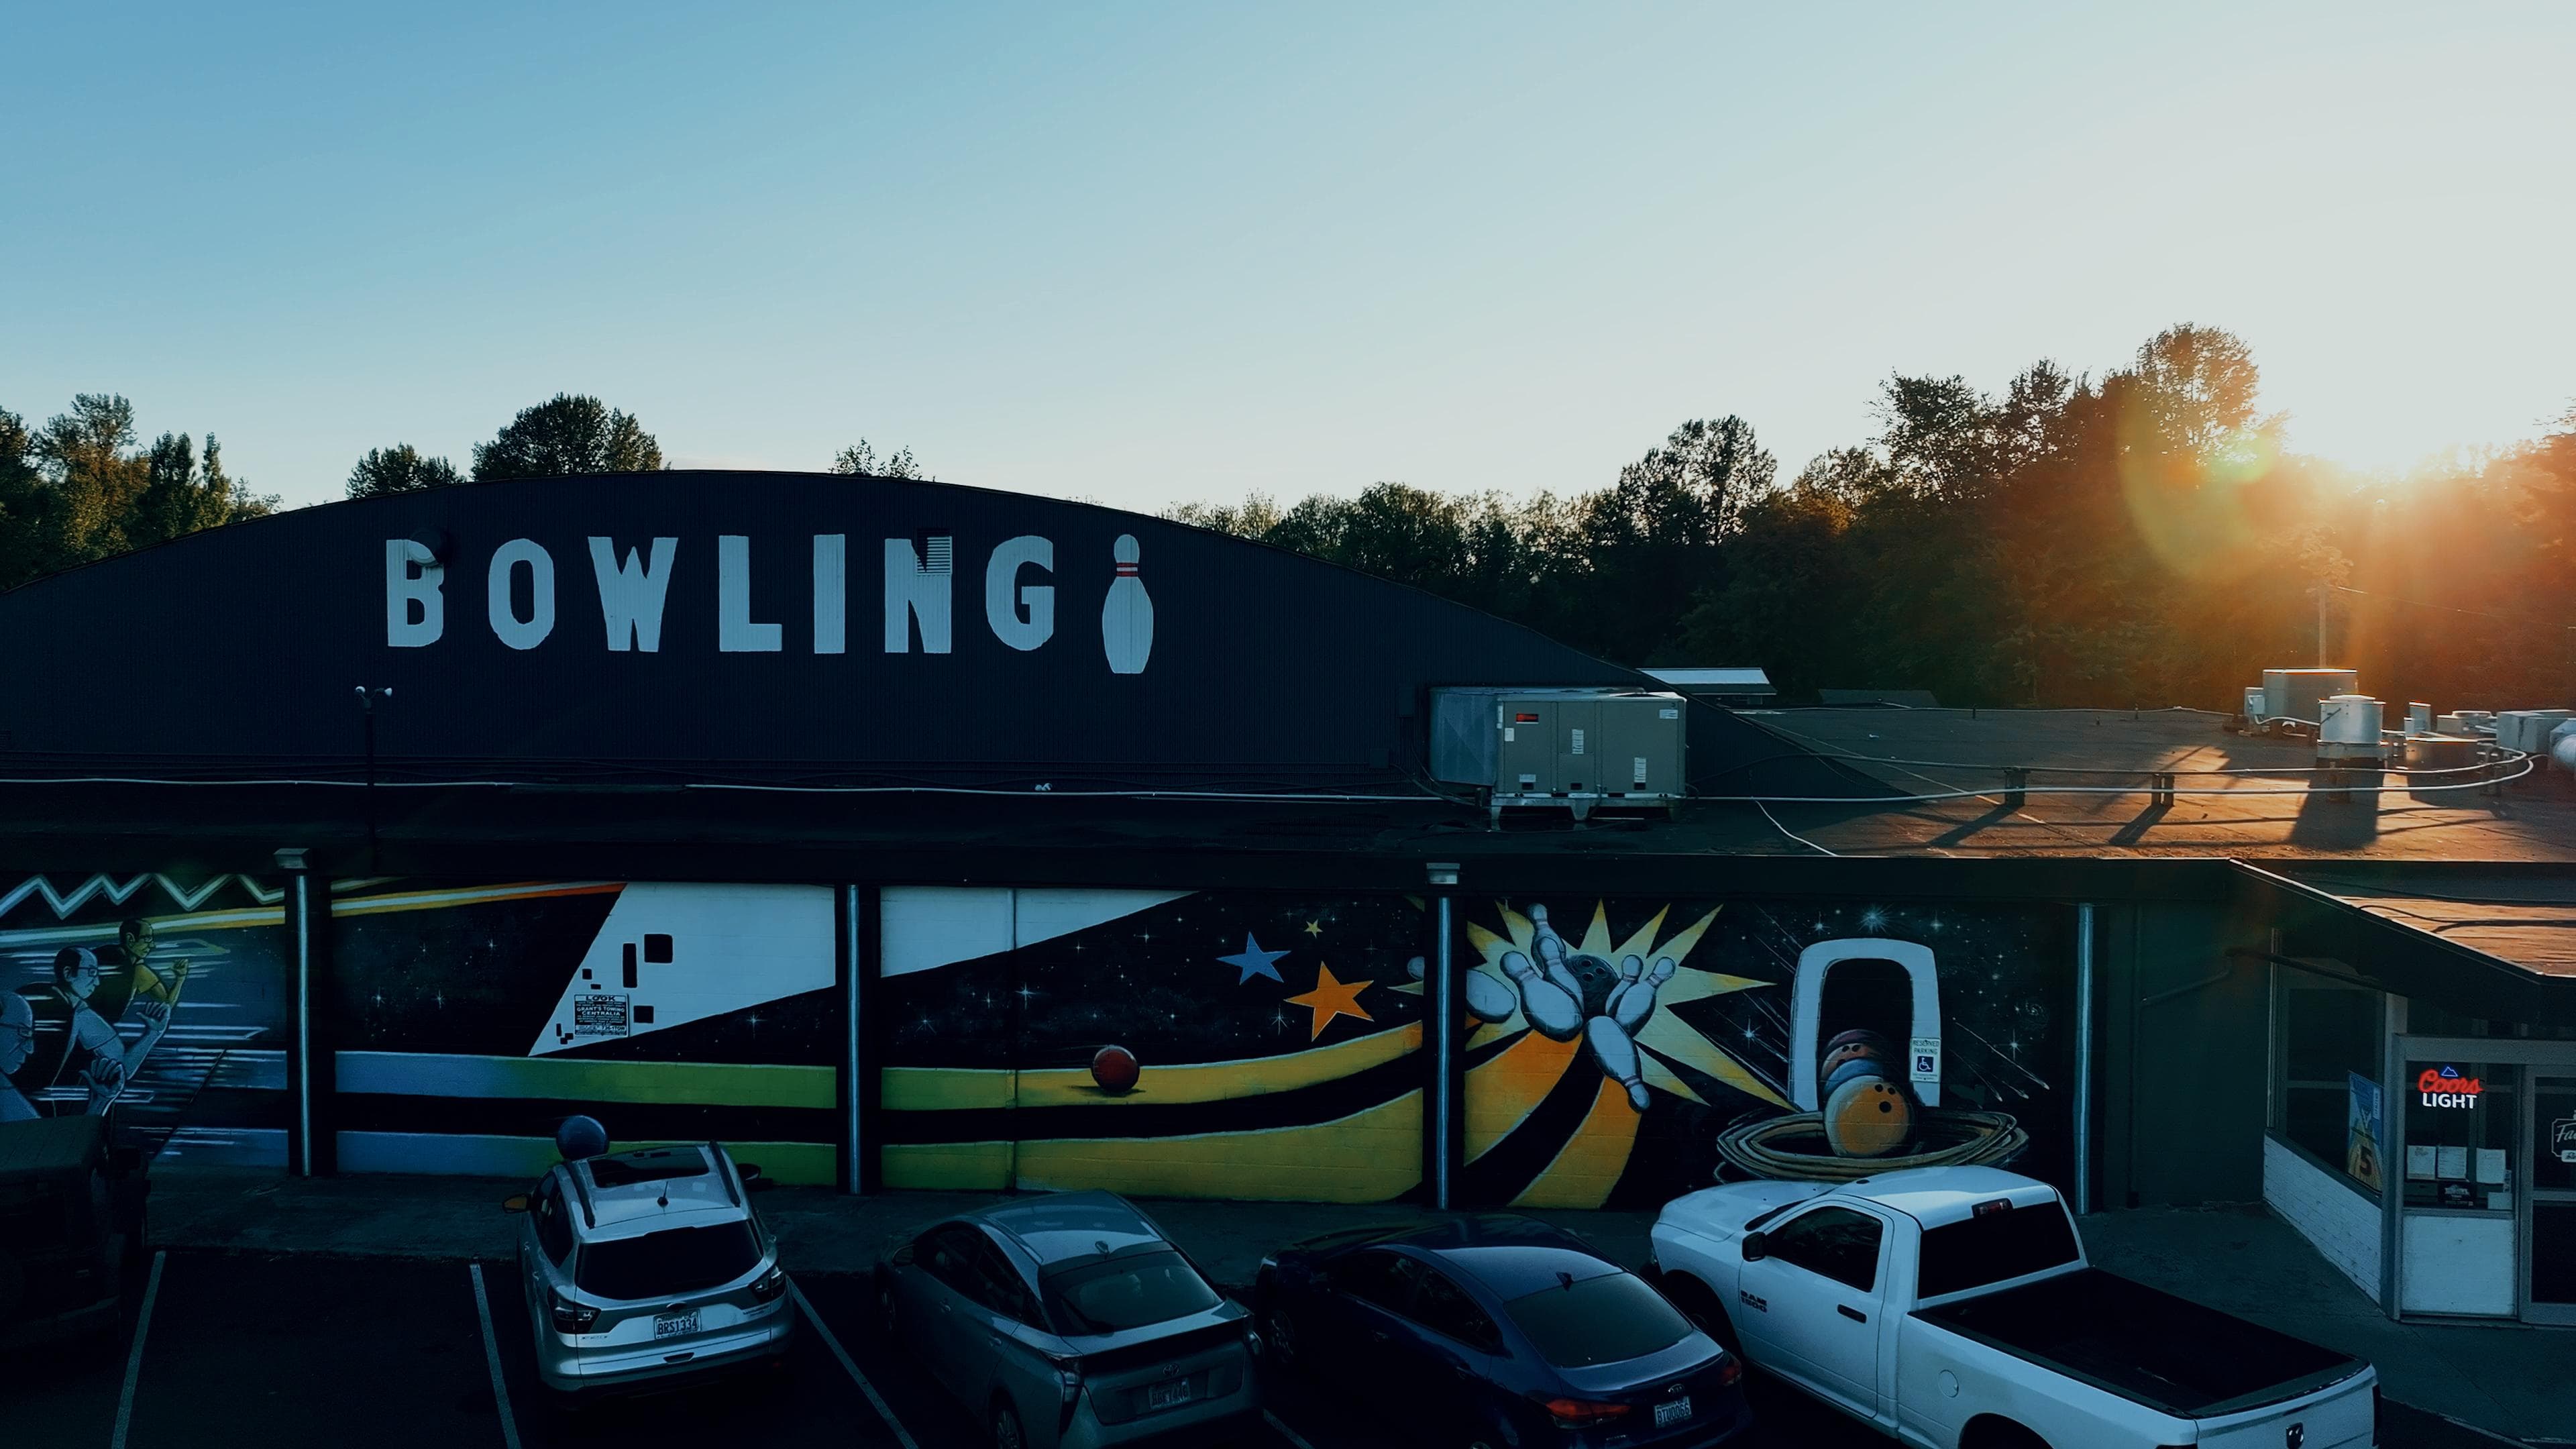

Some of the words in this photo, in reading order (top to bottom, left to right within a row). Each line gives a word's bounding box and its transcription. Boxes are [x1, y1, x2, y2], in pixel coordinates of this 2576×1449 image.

[386, 534, 1055, 653] BOWLING
[2417, 1068, 2483, 1094] Coors
[2422, 1093, 2477, 1109] LIGHT
[1741, 1290, 1767, 1306] RAM
[1741, 1297, 1767, 1313] 1500
[657, 1318, 698, 1335] BRS1334
[1657, 1403, 1690, 1423] BTU0066
